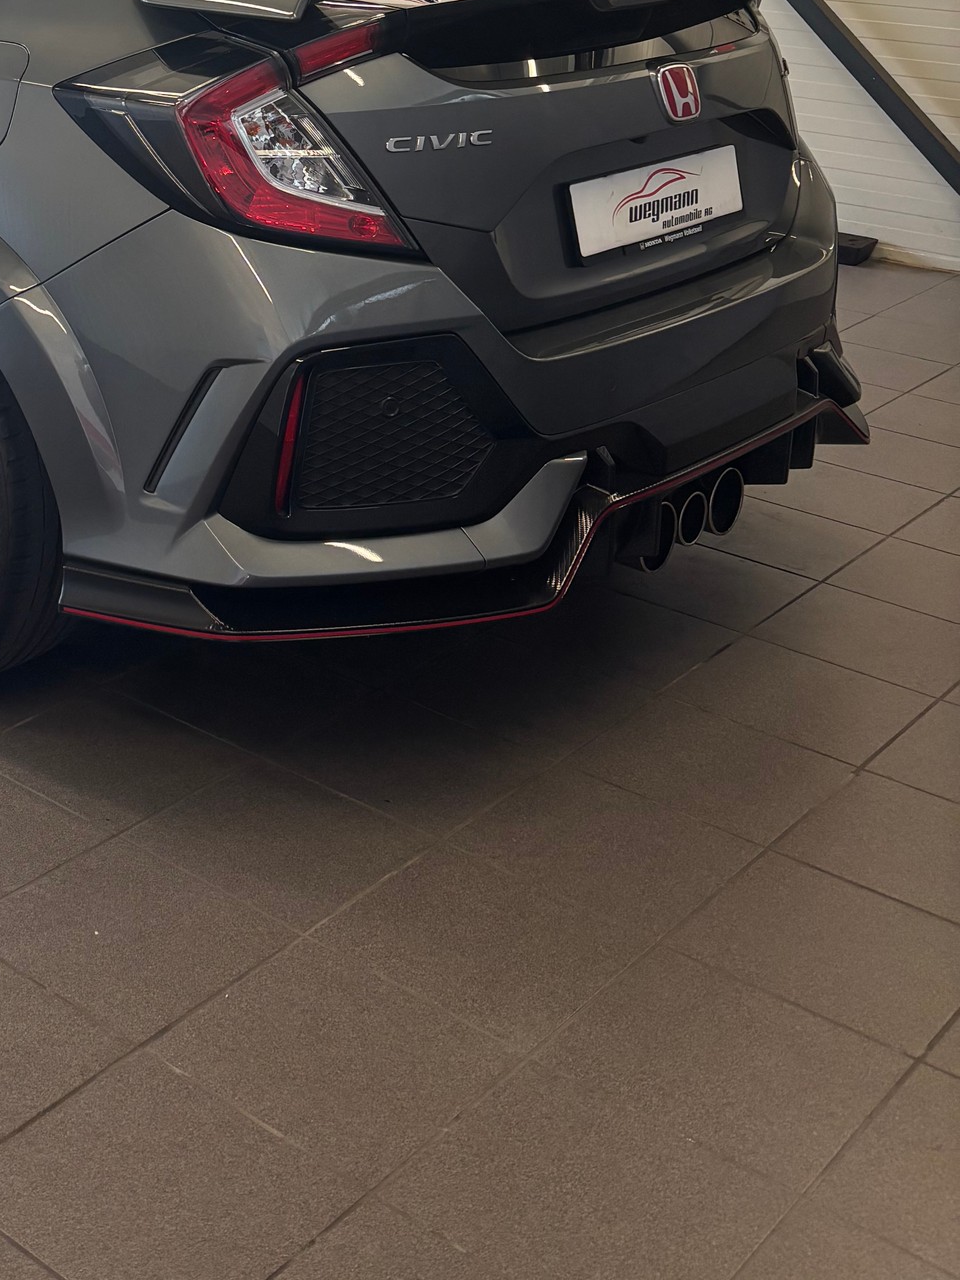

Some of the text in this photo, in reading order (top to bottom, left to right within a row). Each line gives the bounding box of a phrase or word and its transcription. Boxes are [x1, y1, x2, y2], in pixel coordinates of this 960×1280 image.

[385, 130, 492, 152] CIVIC
[629, 188, 699, 223] wegmann
[704, 206, 713, 217] AG
